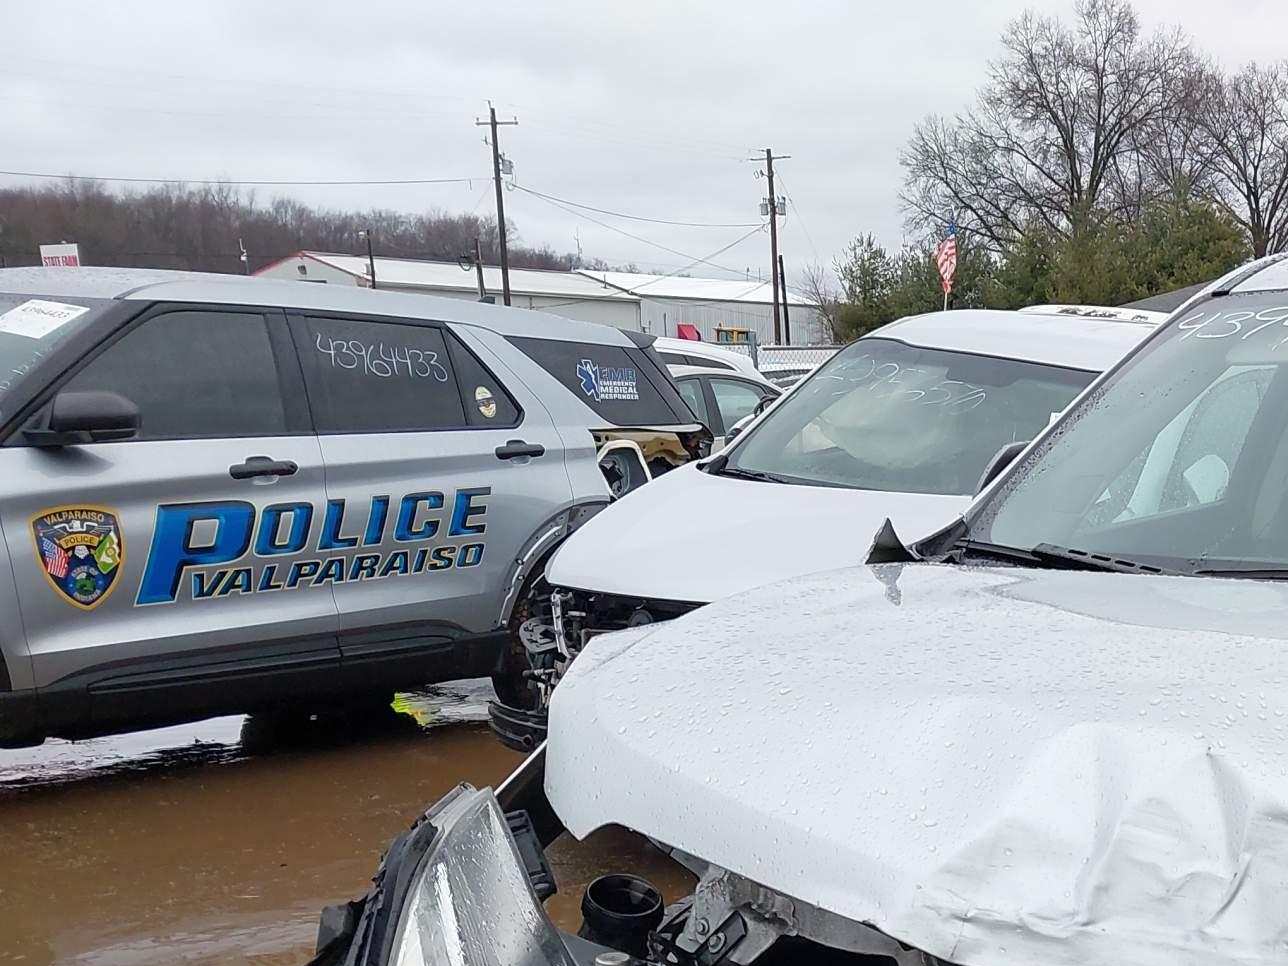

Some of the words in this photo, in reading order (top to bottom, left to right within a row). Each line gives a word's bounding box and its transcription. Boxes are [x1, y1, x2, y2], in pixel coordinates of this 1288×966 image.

[316, 332, 448, 382] 43964433
[600, 386, 638, 394] MEDICAL
[44, 510, 105, 525] VALPARAISO
[64, 536, 96, 547] POLICE
[133, 486, 493, 607] POLICE
[191, 543, 486, 600] VALPARAISO
